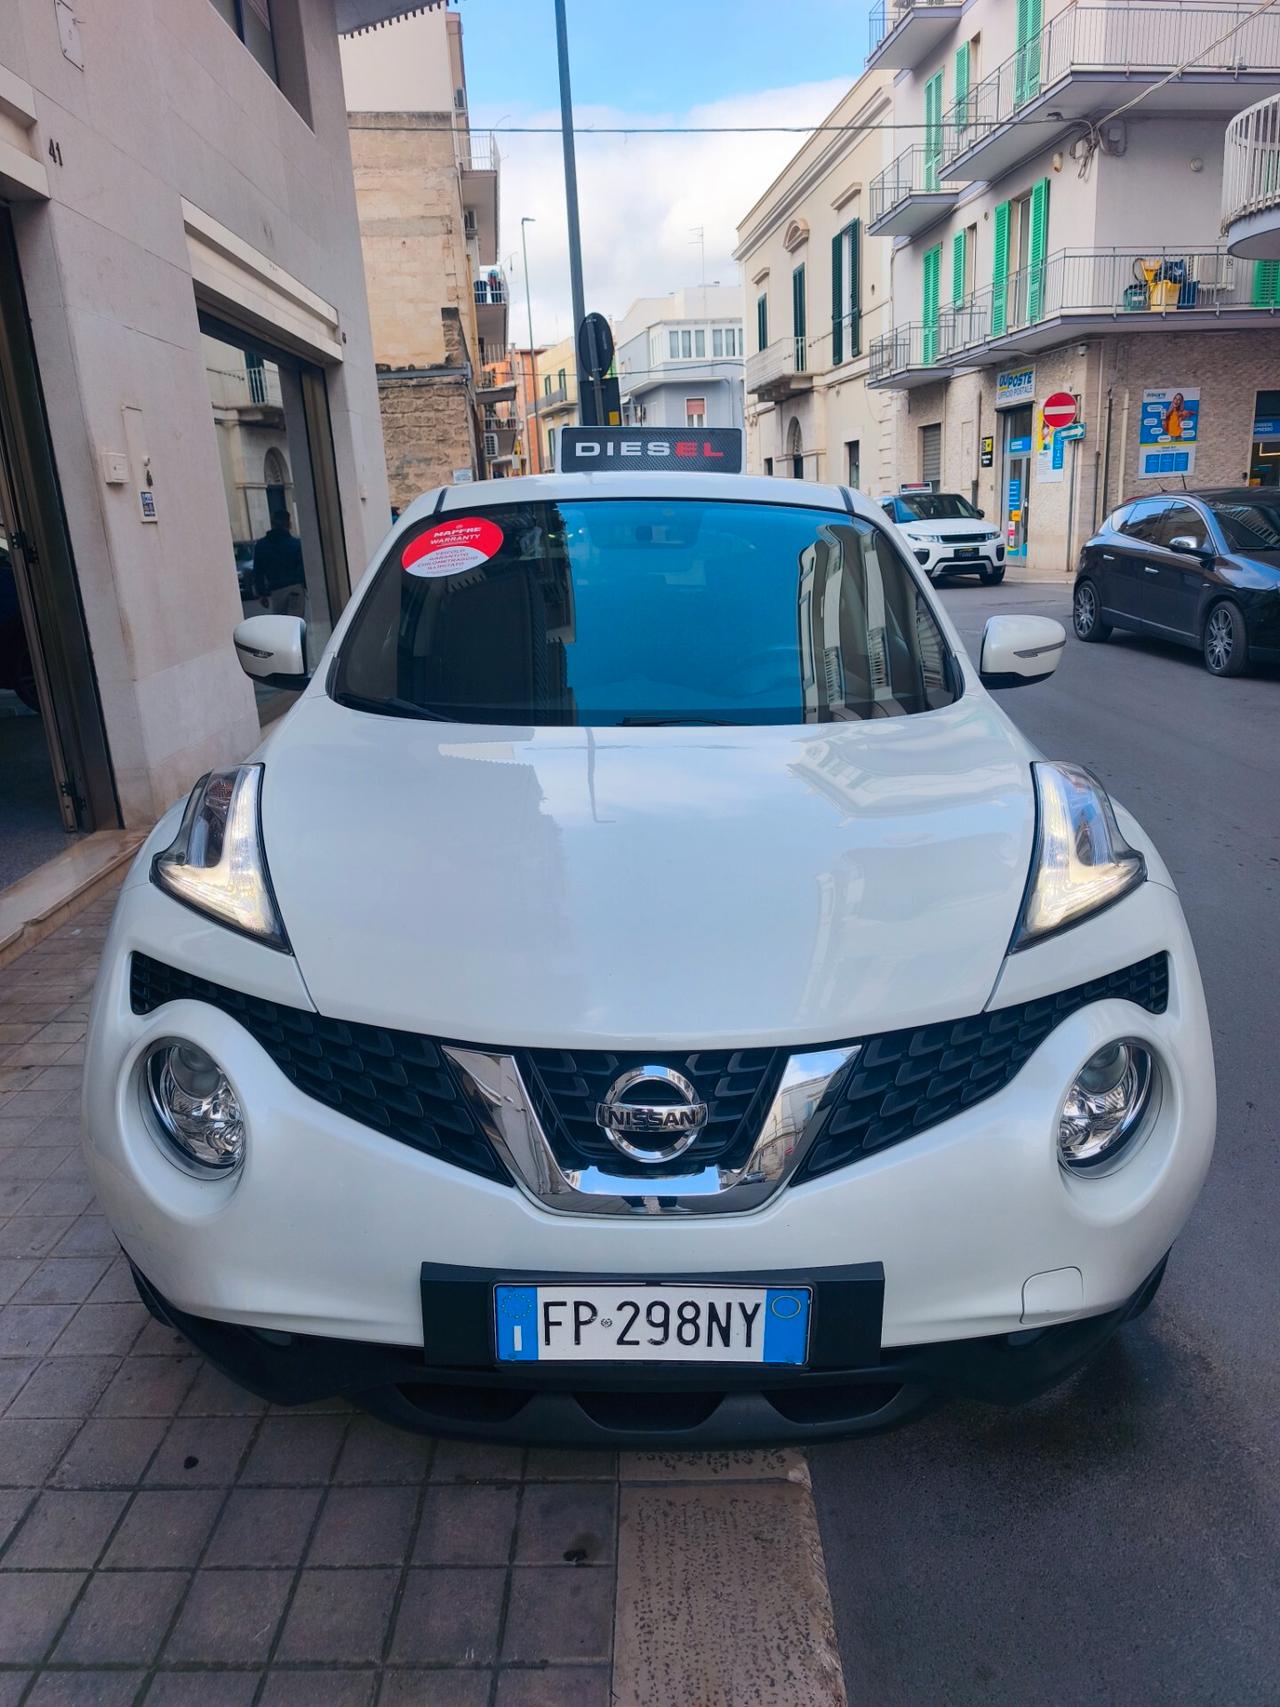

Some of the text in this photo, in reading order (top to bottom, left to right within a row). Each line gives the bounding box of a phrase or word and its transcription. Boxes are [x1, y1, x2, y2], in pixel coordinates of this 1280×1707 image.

[49, 138, 63, 167] 41
[575, 441, 724, 458] DIESEL
[430, 534, 480, 545] WARRANTY
[433, 527, 482, 538] MAPFRE
[608, 1108, 696, 1126] NISSAN
[543, 1300, 762, 1348] FP 298NY
